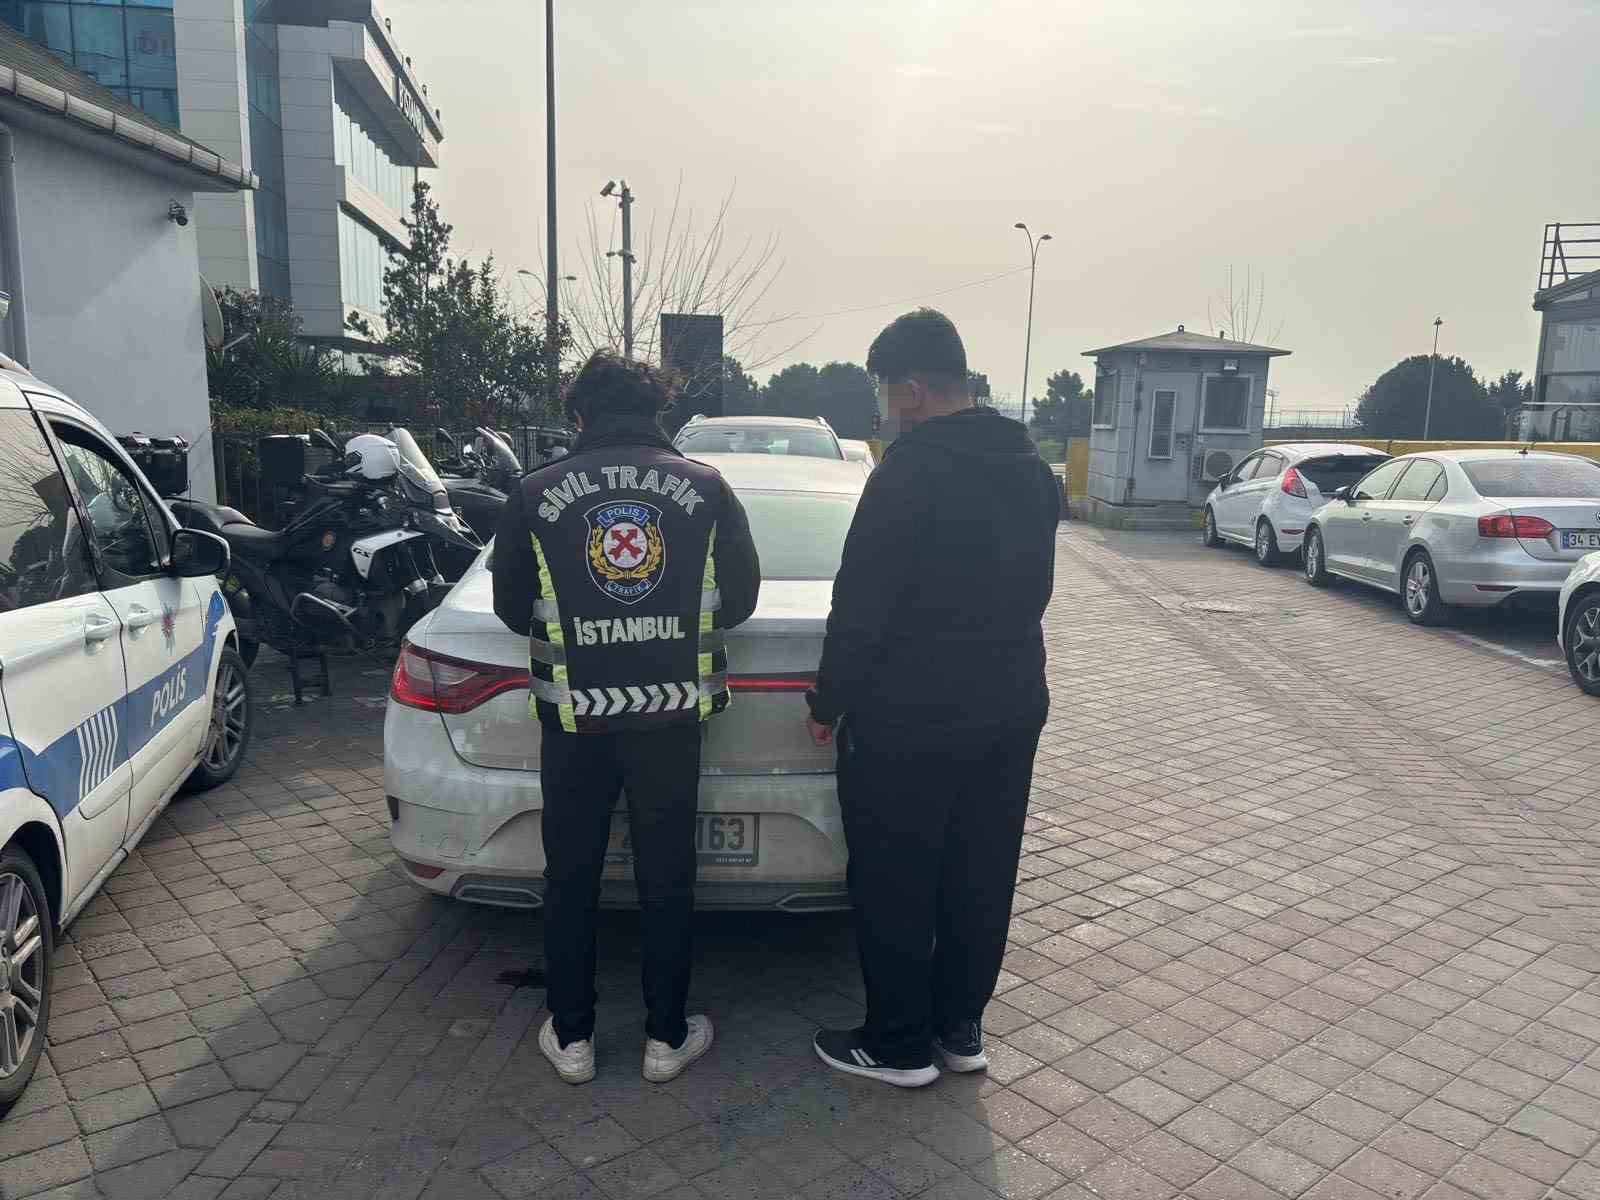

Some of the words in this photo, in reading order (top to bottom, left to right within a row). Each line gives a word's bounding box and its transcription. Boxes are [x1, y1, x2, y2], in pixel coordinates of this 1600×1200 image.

[538, 472, 600, 522] SİVİL
[602, 466, 705, 515] TRAFİK
[1571, 534, 1584, 546] 34
[574, 616, 686, 646] İSTANBUL
[151, 664, 187, 727] POLİS
